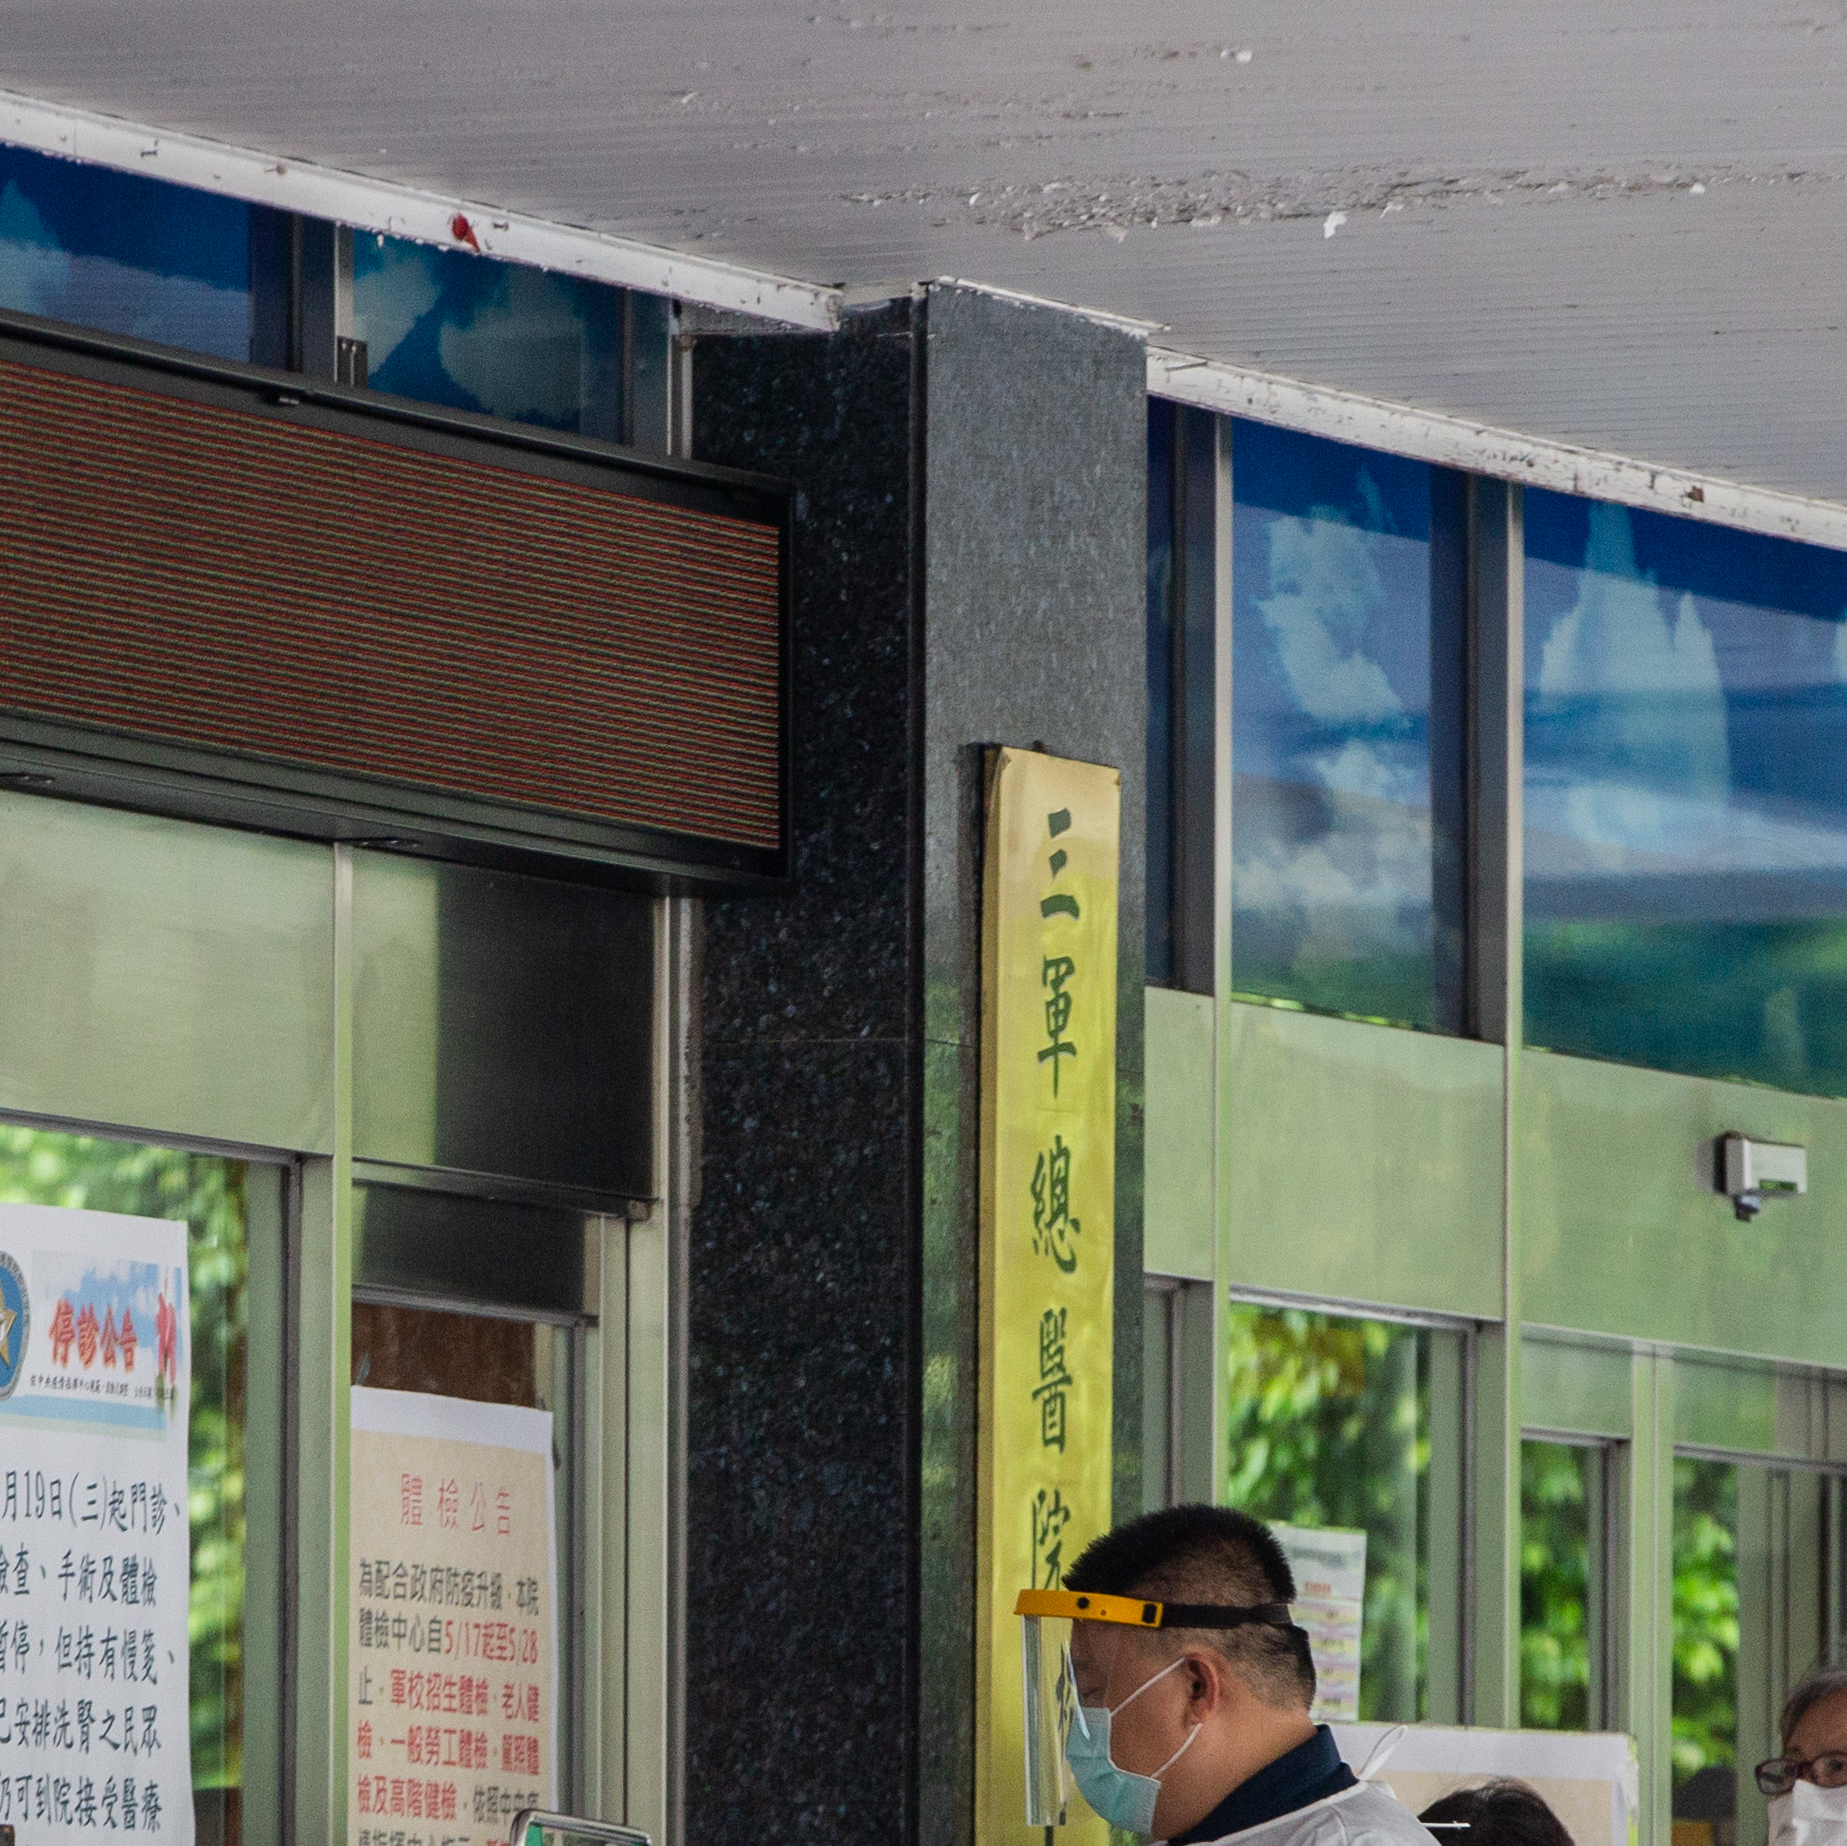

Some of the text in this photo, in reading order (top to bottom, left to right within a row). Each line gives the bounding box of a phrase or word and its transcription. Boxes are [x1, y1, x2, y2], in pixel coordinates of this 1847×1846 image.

[48, 1298, 138, 1374] 停診公告
[401, 1473, 511, 1536] 體檢公告
